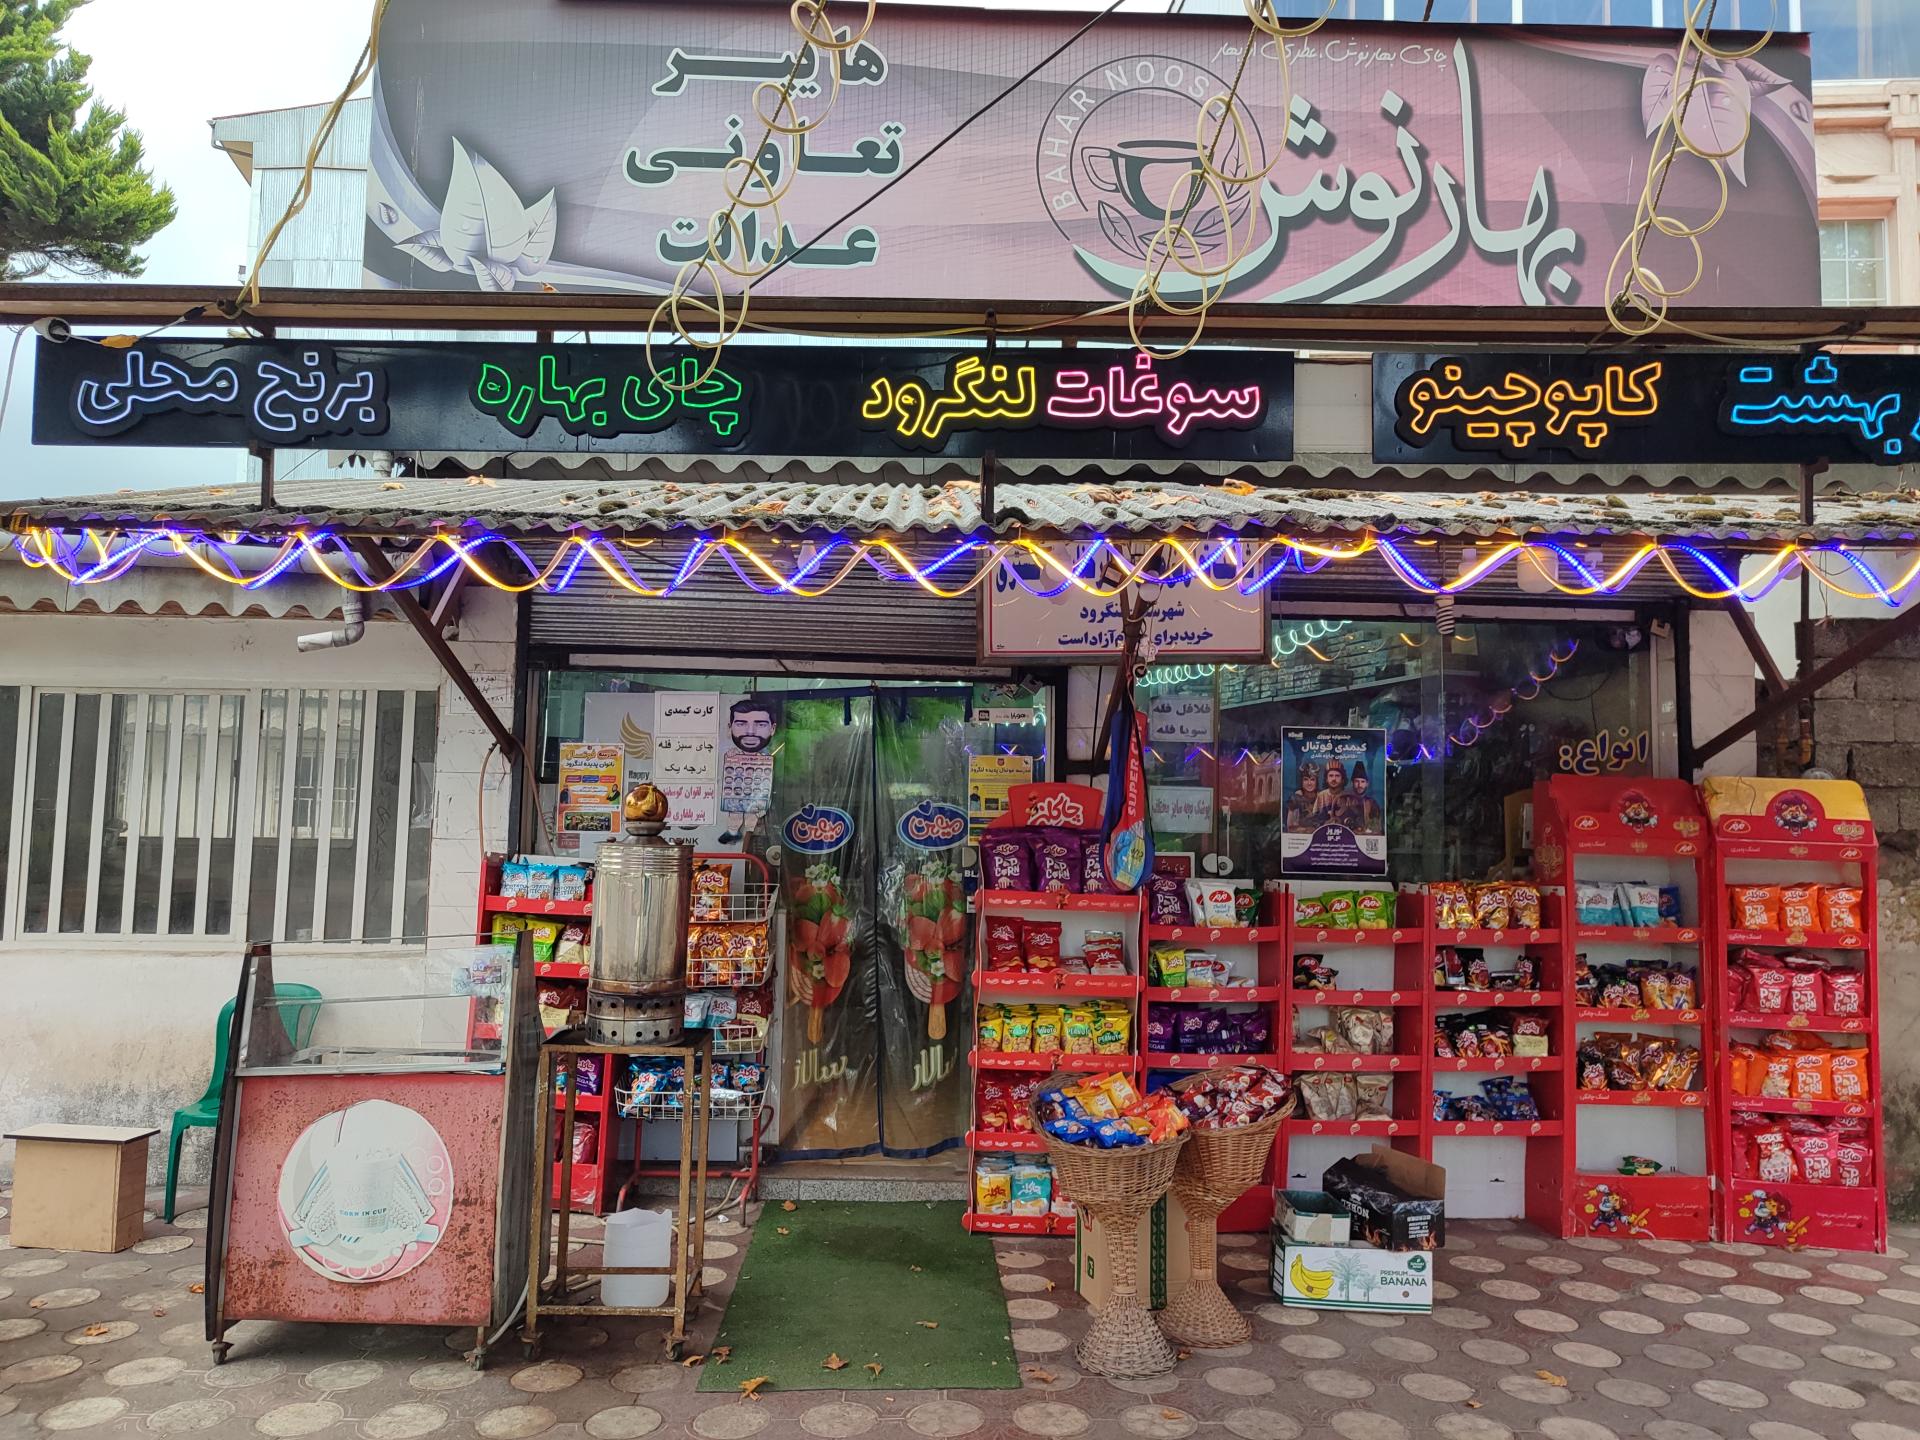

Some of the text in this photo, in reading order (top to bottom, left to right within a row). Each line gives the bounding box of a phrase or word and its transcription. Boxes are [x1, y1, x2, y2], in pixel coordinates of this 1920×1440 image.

[1400, 45, 1446, 71] چای
[623, 112, 906, 189] تعاونی
[1044, 88, 1096, 212] BAHAR
[1072, 37, 1577, 305] بهارنوش
[655, 209, 880, 270] عدالت
[77, 350, 375, 432] برنج محلی
[476, 355, 742, 435] چای بهاره
[862, 353, 1260, 438] سوغات لنگرود
[1410, 361, 1662, 447] کاپوچینو
[1080, 602, 1123, 624] نگرود
[1058, 631, 1088, 646] است
[1153, 628, 1179, 646] برای
[1180, 627, 1214, 645] خرید
[664, 706, 714, 717] کارت کیمدی
[1153, 703, 1211, 717] فلافل فله
[1156, 724, 1207, 737] سویا فله
[658, 739, 714, 753] چای سبز فله
[1301, 740, 1367, 754] کیمدی فوتبال
[664, 763, 706, 775] درجه یک
[703, 788, 714, 799] پنیر
[1128, 759, 1139, 817] SUPER
[695, 810, 706, 821] پنیر
[1027, 792, 1084, 827] چاکلز
[791, 817, 845, 843] میهن
[908, 814, 964, 840] میهن
[669, 837, 700, 846] DINK
[372, 1207, 387, 1215] CUP
[1341, 1198, 1370, 1219] NOBEL
[1380, 1276, 1427, 1287] BANANA
